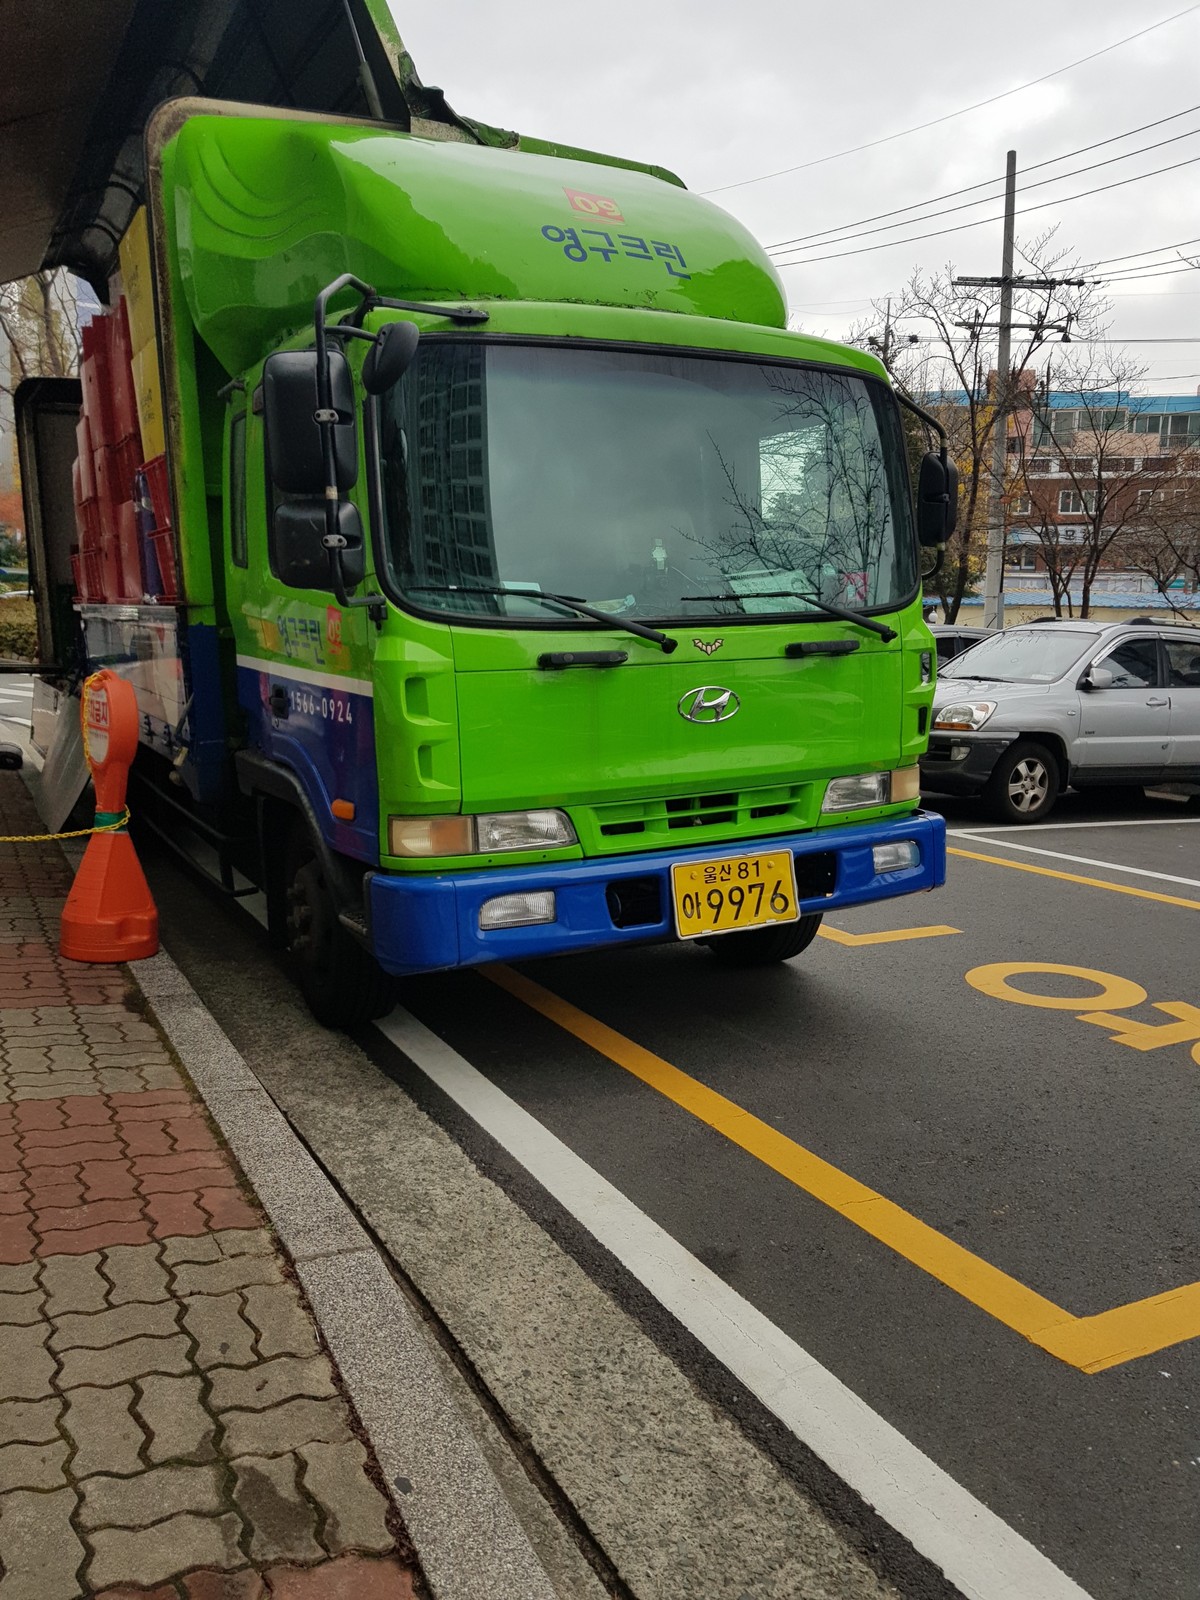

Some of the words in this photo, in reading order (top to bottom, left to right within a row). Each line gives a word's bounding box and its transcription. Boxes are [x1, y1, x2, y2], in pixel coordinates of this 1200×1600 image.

[541, 224, 692, 280] 영구크린
[290, 690, 353, 725] 1566-0924
[703, 863, 732, 884] 울산
[737, 860, 760, 880] 81
